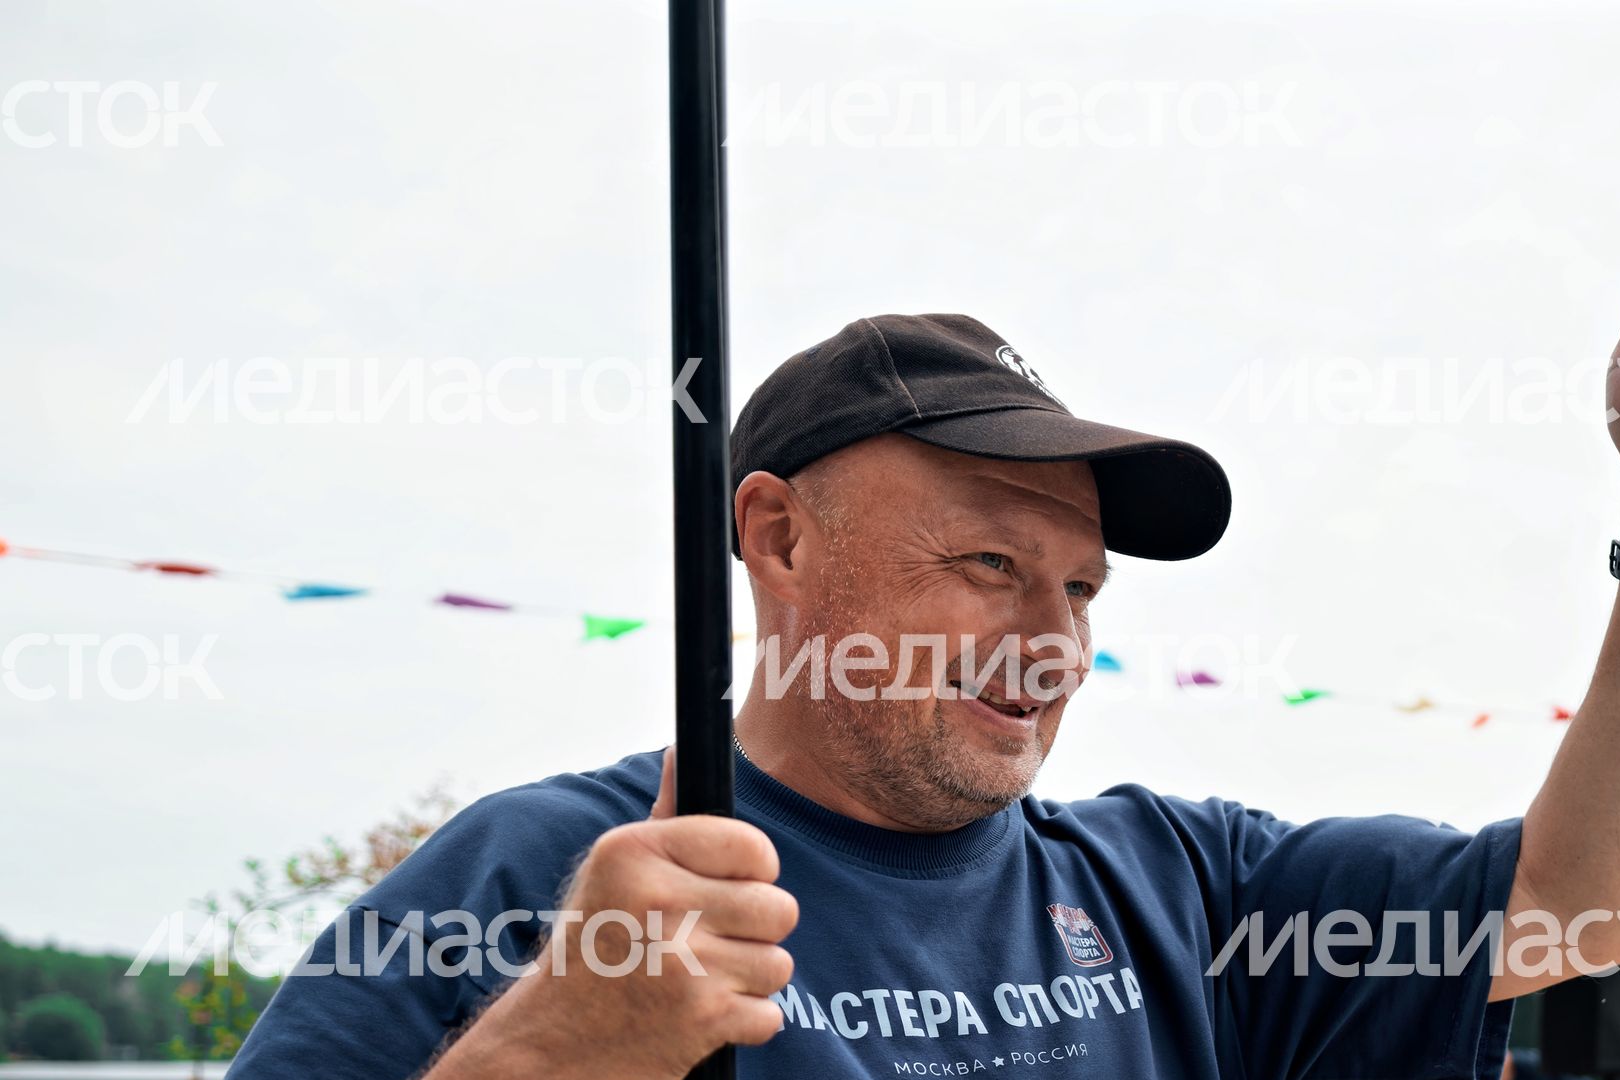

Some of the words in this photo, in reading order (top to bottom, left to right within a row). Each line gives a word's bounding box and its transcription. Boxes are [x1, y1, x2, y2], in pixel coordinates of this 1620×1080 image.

[769, 983, 989, 1040] МАСТЕРА
[993, 967, 1143, 1028] СПОРТА
[893, 1058, 986, 1077] МОСКВА
[1010, 1042, 1089, 1066] РОССИЯ
